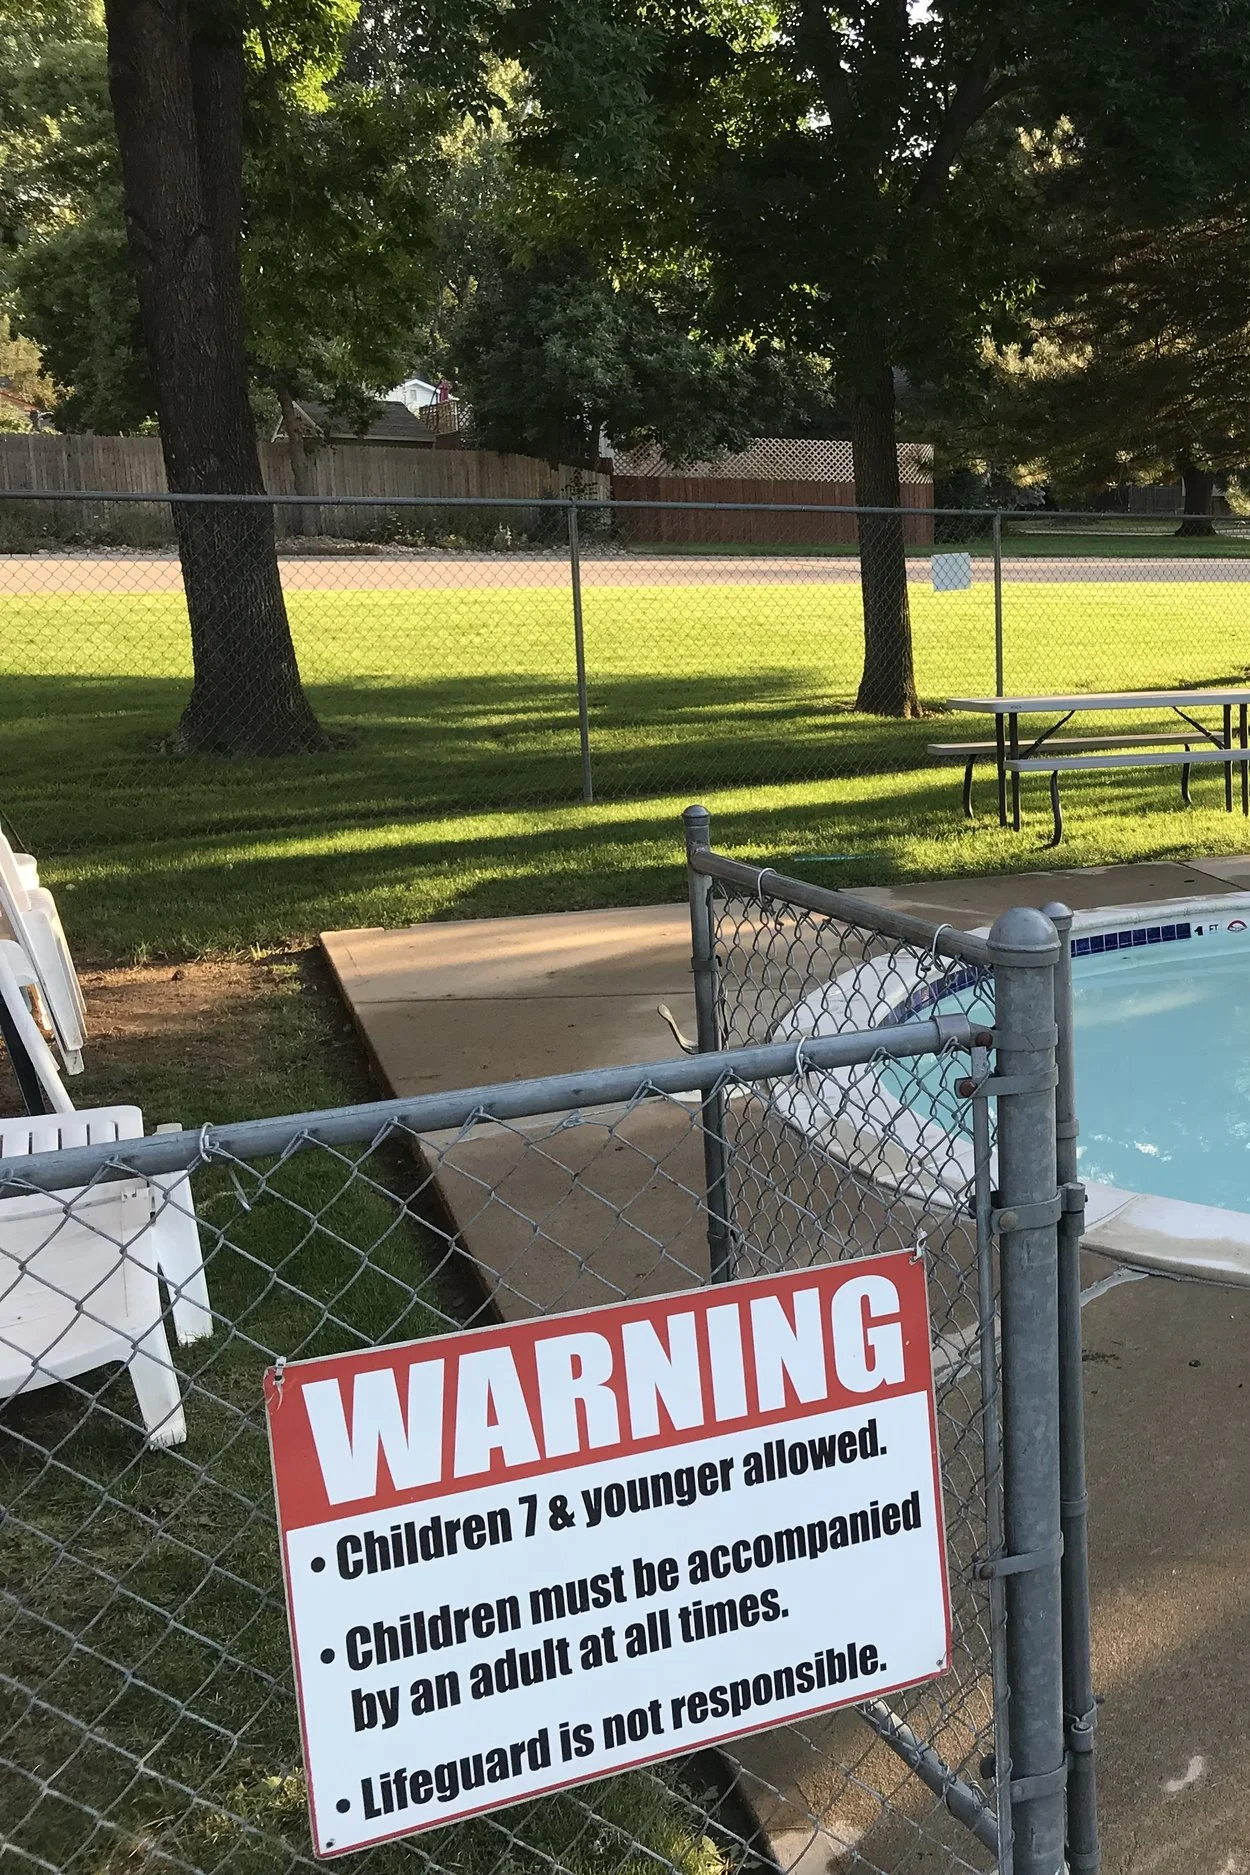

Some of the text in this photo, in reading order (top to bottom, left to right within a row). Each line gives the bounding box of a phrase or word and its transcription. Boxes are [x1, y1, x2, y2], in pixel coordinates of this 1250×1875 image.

[1194, 926, 1203, 936] 1
[302, 1275, 906, 1505] WARNING
[337, 1419, 887, 1579] Children 7 & younger allowed.
[346, 1491, 921, 1670] Children must be accompanied
[351, 1589, 788, 1732] by an adult at all times.
[361, 1642, 886, 1820] Lifeguard is not responsible.
